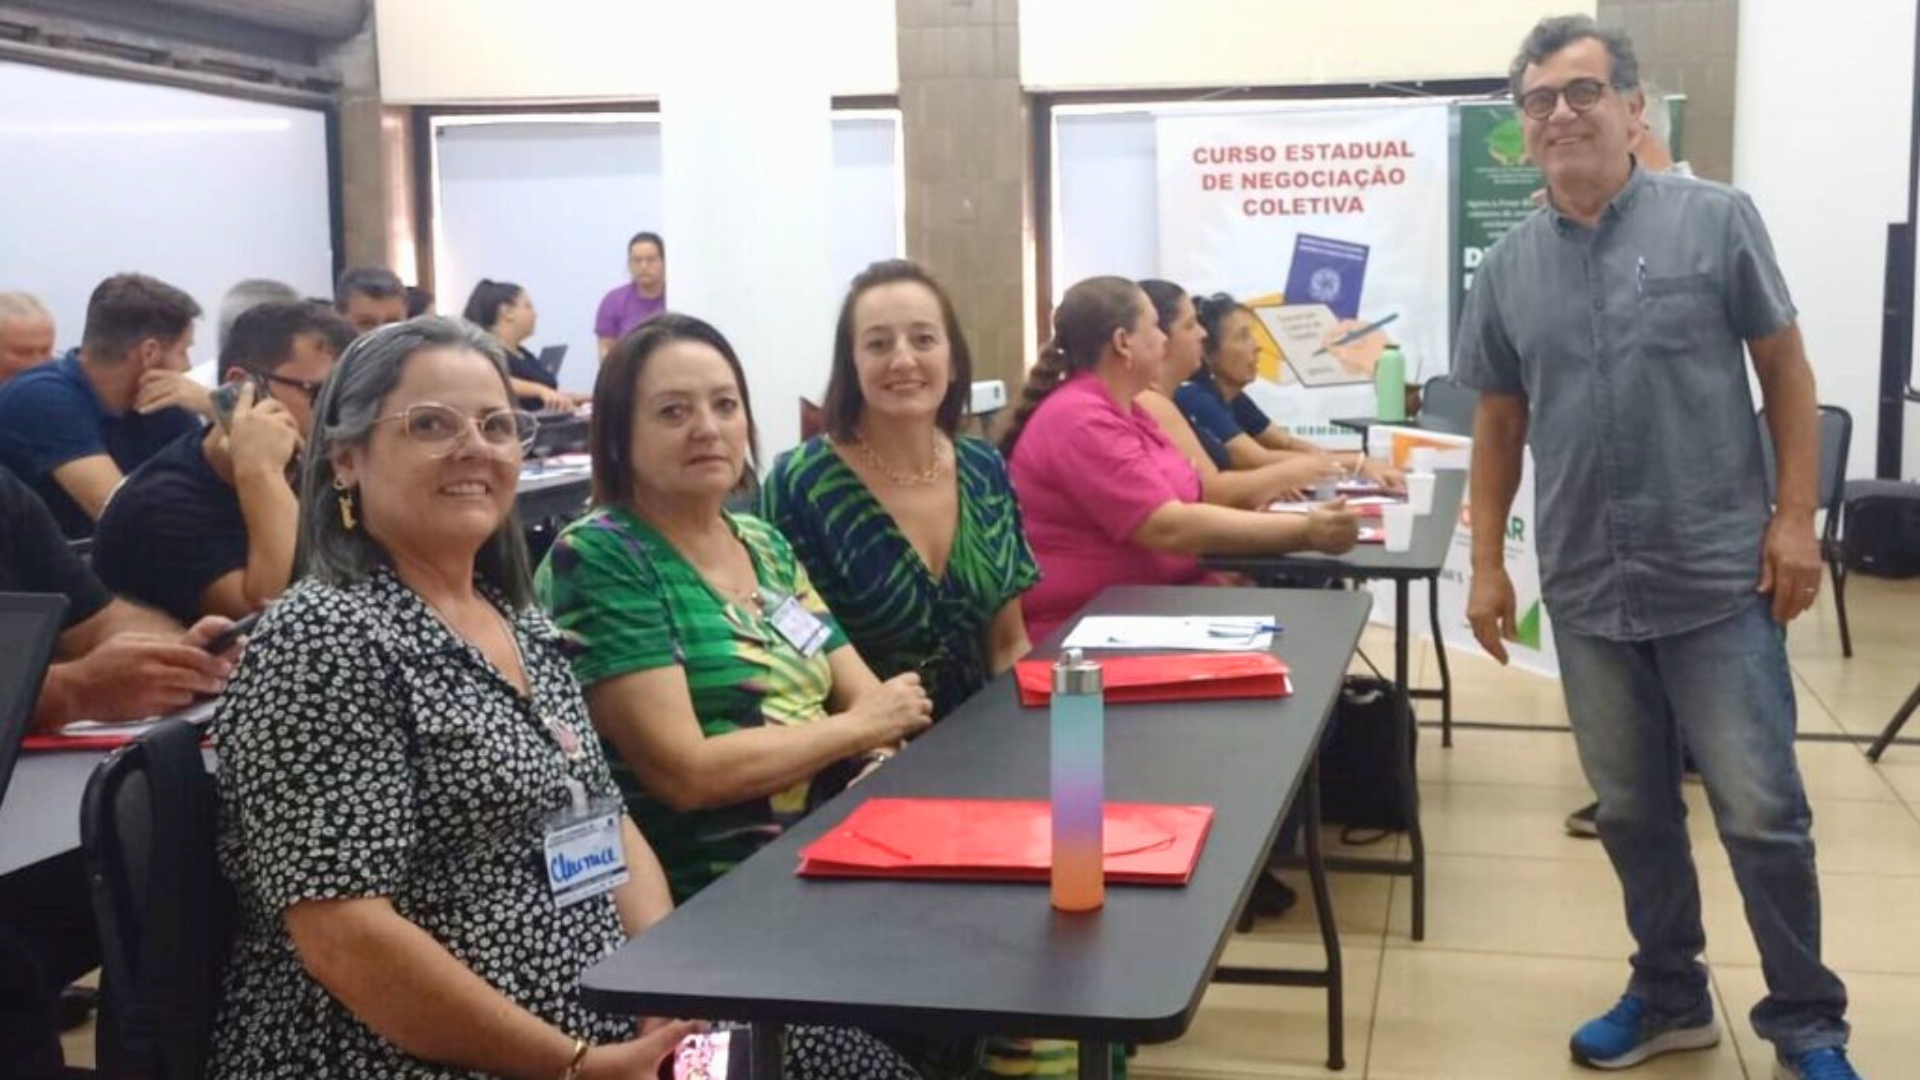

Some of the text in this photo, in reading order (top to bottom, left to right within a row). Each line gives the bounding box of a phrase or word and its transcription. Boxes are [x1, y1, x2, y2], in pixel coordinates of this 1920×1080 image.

[1193, 140, 1415, 164] CURSO ESTADUAL
[1202, 165, 1406, 191] DE NEGOCIAÇÃO
[1243, 196, 1365, 217] COLETIVA
